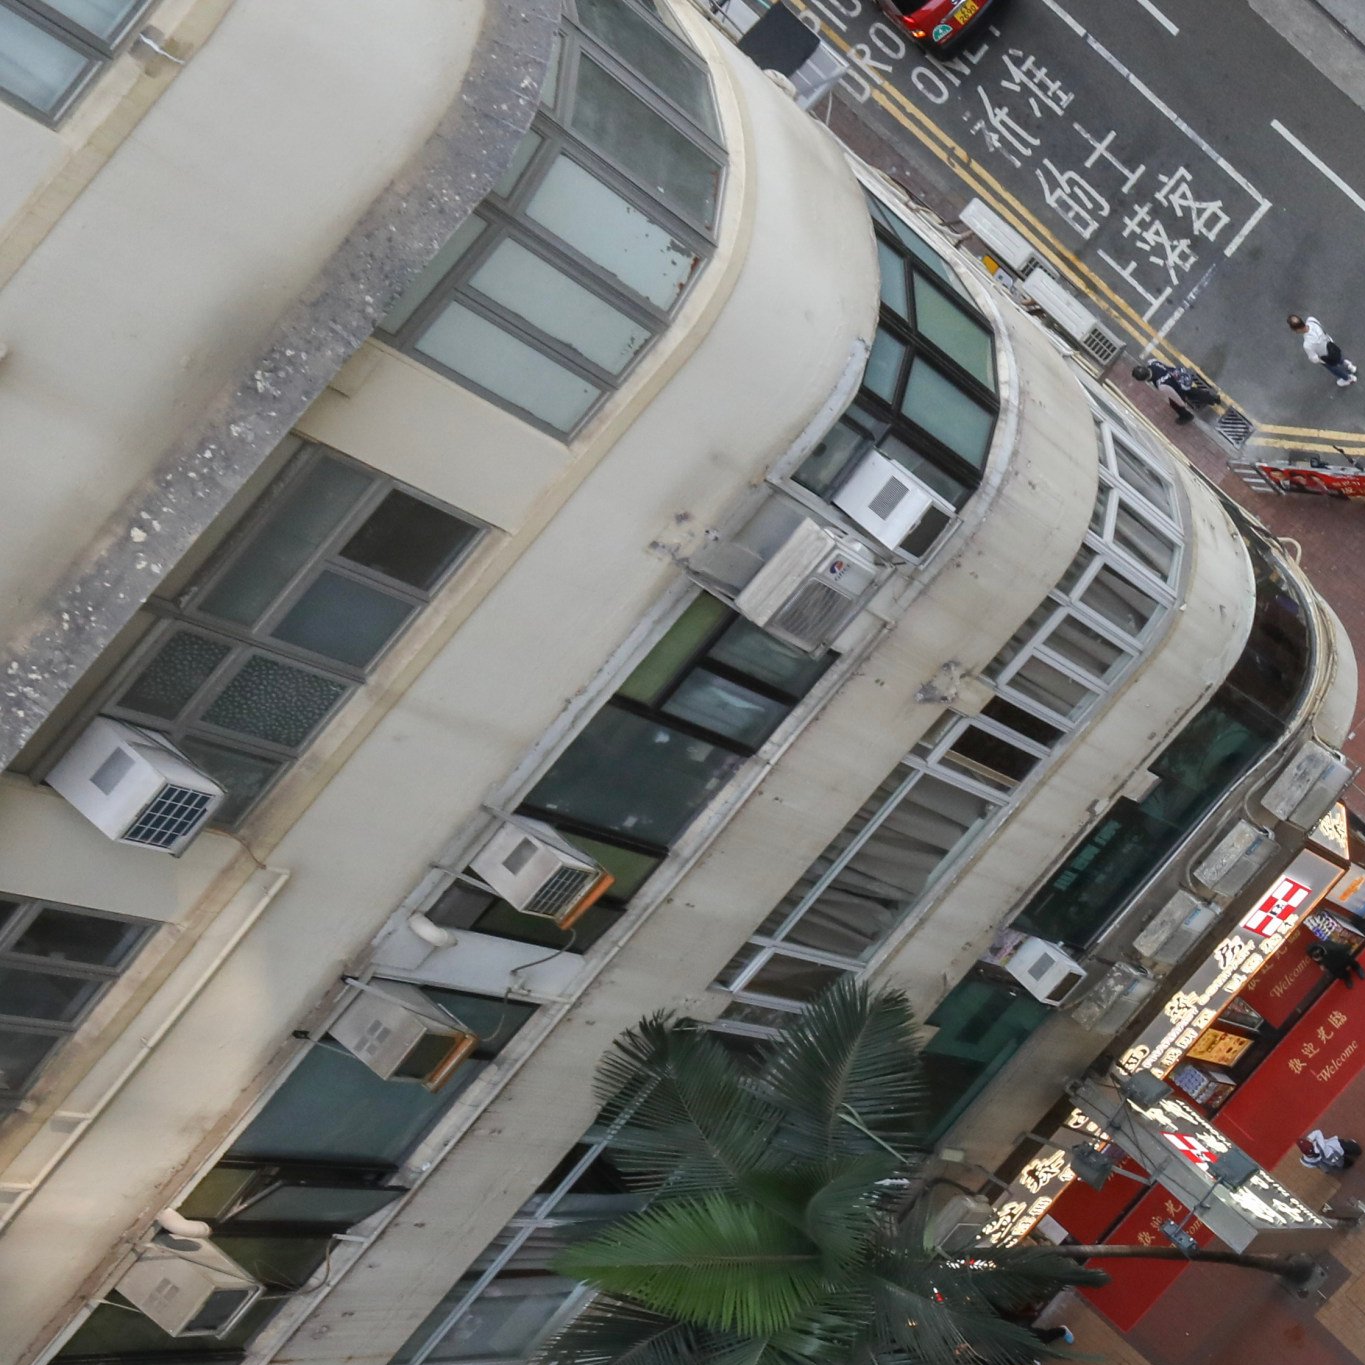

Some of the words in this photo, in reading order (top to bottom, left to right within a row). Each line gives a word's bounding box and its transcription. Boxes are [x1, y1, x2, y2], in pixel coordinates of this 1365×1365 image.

[1035, 122, 1146, 239] 的士
[1097, 166, 1231, 323] 上落客
[1287, 1010, 1348, 1074] 歡迎光臨
[1316, 1040, 1359, 1082] Welcome
